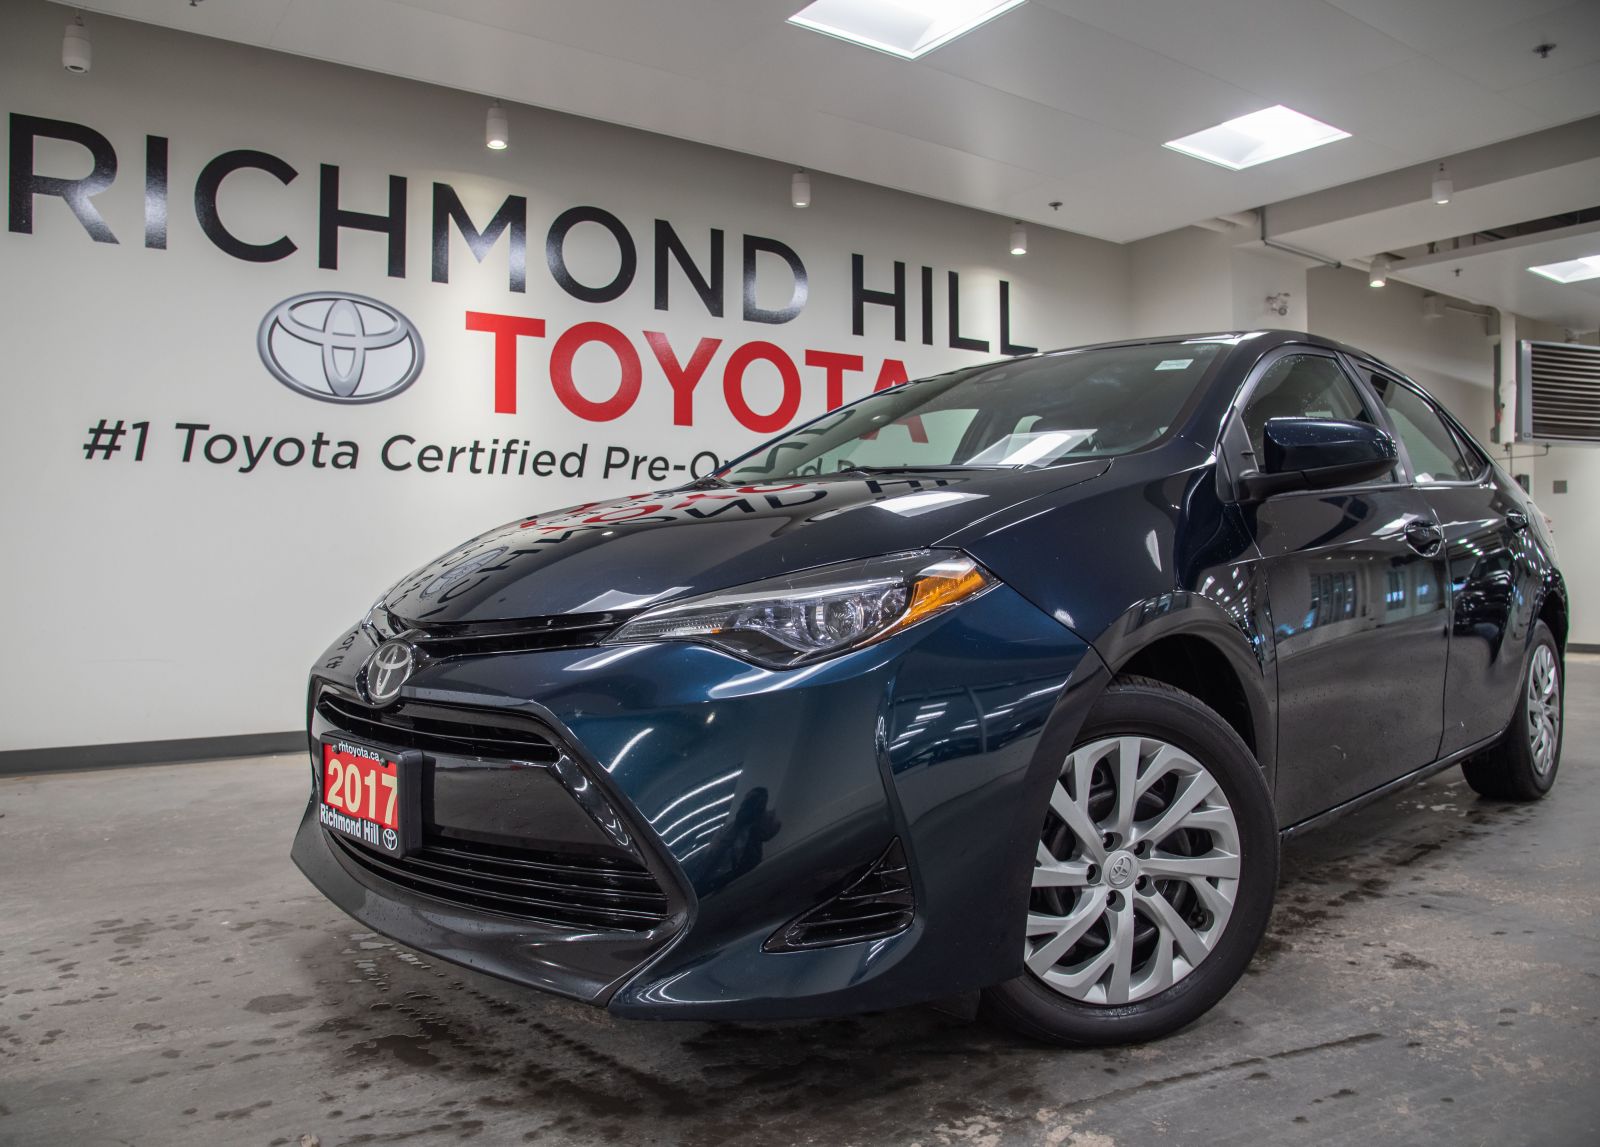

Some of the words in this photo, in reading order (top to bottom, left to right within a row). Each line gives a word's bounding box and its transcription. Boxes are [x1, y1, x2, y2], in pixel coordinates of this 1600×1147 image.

[9, 113, 808, 324] RICHMOND
[852, 253, 1038, 357] HILL
[465, 310, 929, 444] TOYOTA
[83, 419, 150, 461] #1
[175, 422, 360, 474] Toyota
[380, 434, 588, 479] Certified
[338, 741, 380, 762] rhtoyota.ca
[320, 802, 362, 839] Richmond
[363, 819, 380, 846] Hill
[327, 758, 398, 826] 2017
